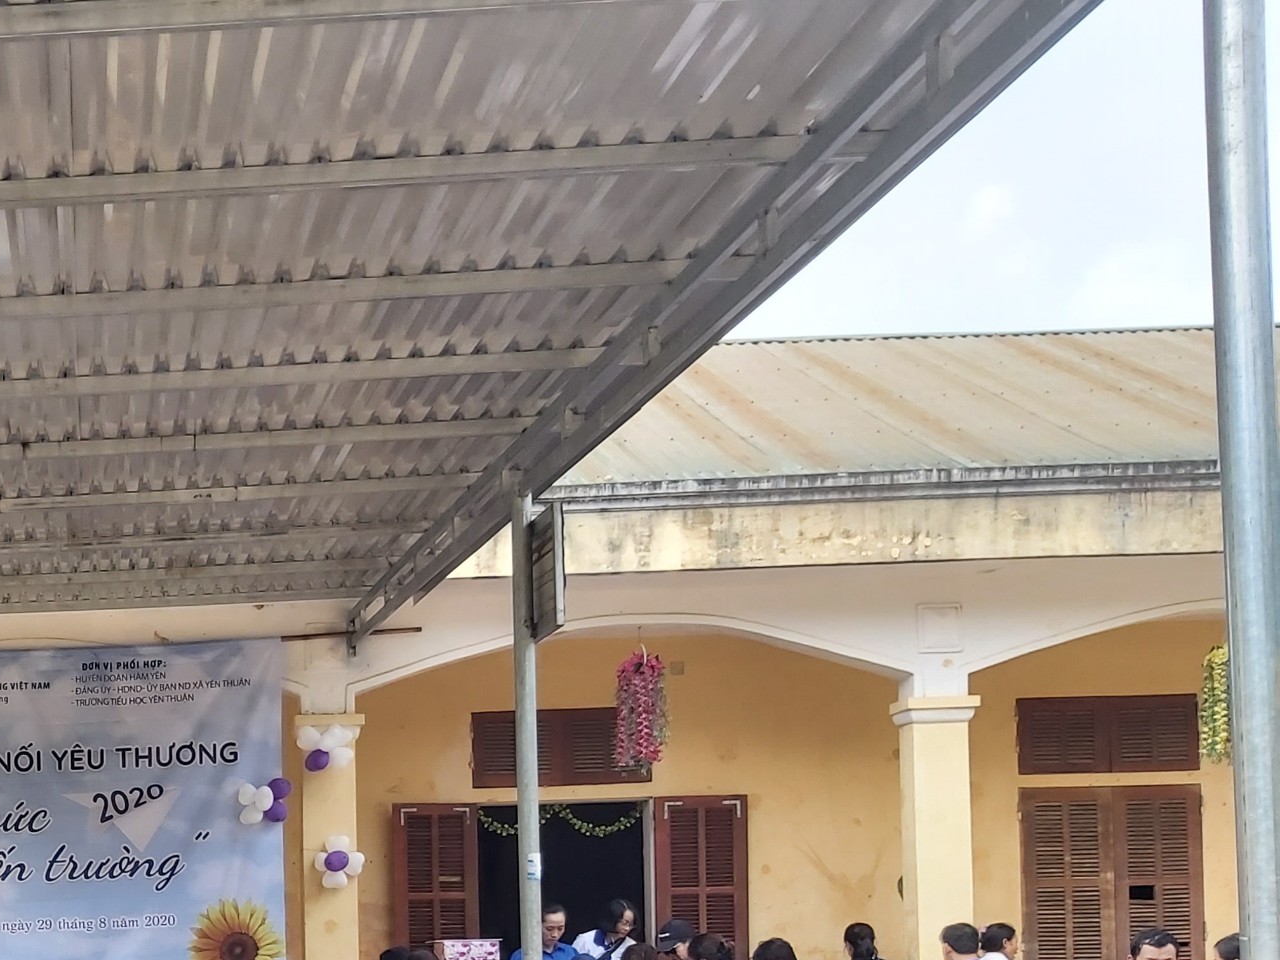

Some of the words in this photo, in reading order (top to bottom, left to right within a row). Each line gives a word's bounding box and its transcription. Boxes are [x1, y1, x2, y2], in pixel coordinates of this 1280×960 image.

[31, 681, 51, 690] NAM
[52, 743, 105, 771] YÊU
[115, 741, 239, 768] THƯƠNG
[92, 783, 164, 823] 2020
[2, 918, 32, 933] ngày
[37, 919, 53, 930] 29
[58, 918, 94, 932] tháng
[99, 917, 107, 929] 8
[112, 915, 139, 928] năm
[144, 914, 176, 927] 2020
